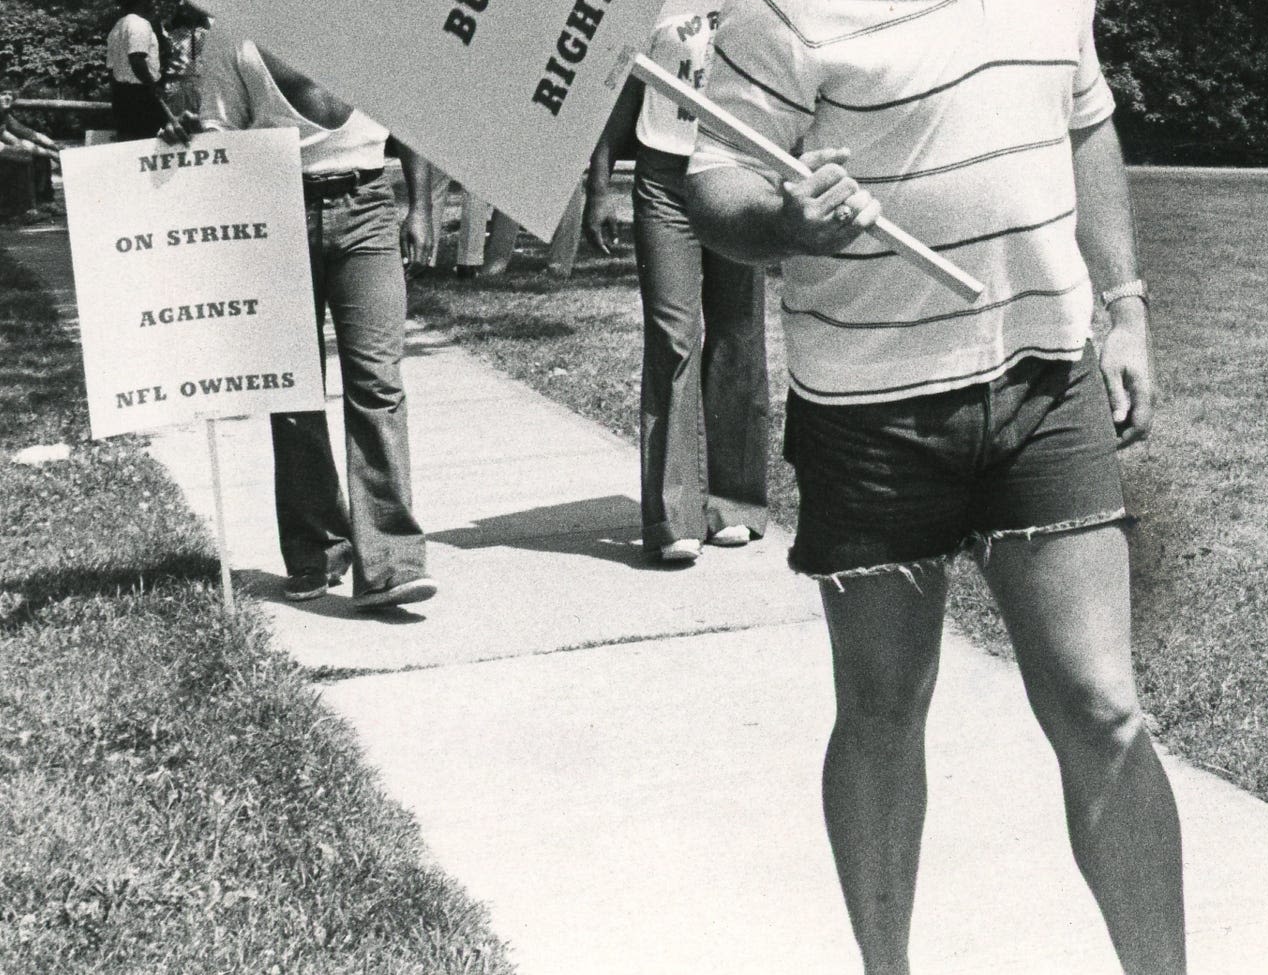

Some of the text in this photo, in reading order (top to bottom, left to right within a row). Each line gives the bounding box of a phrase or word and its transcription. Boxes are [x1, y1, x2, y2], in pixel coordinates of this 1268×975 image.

[139, 147, 230, 173] NFLPA
[115, 222, 268, 253] ON STRIKE
[140, 299, 259, 327] AGAINST
[116, 372, 296, 409] NFL OWNERS
